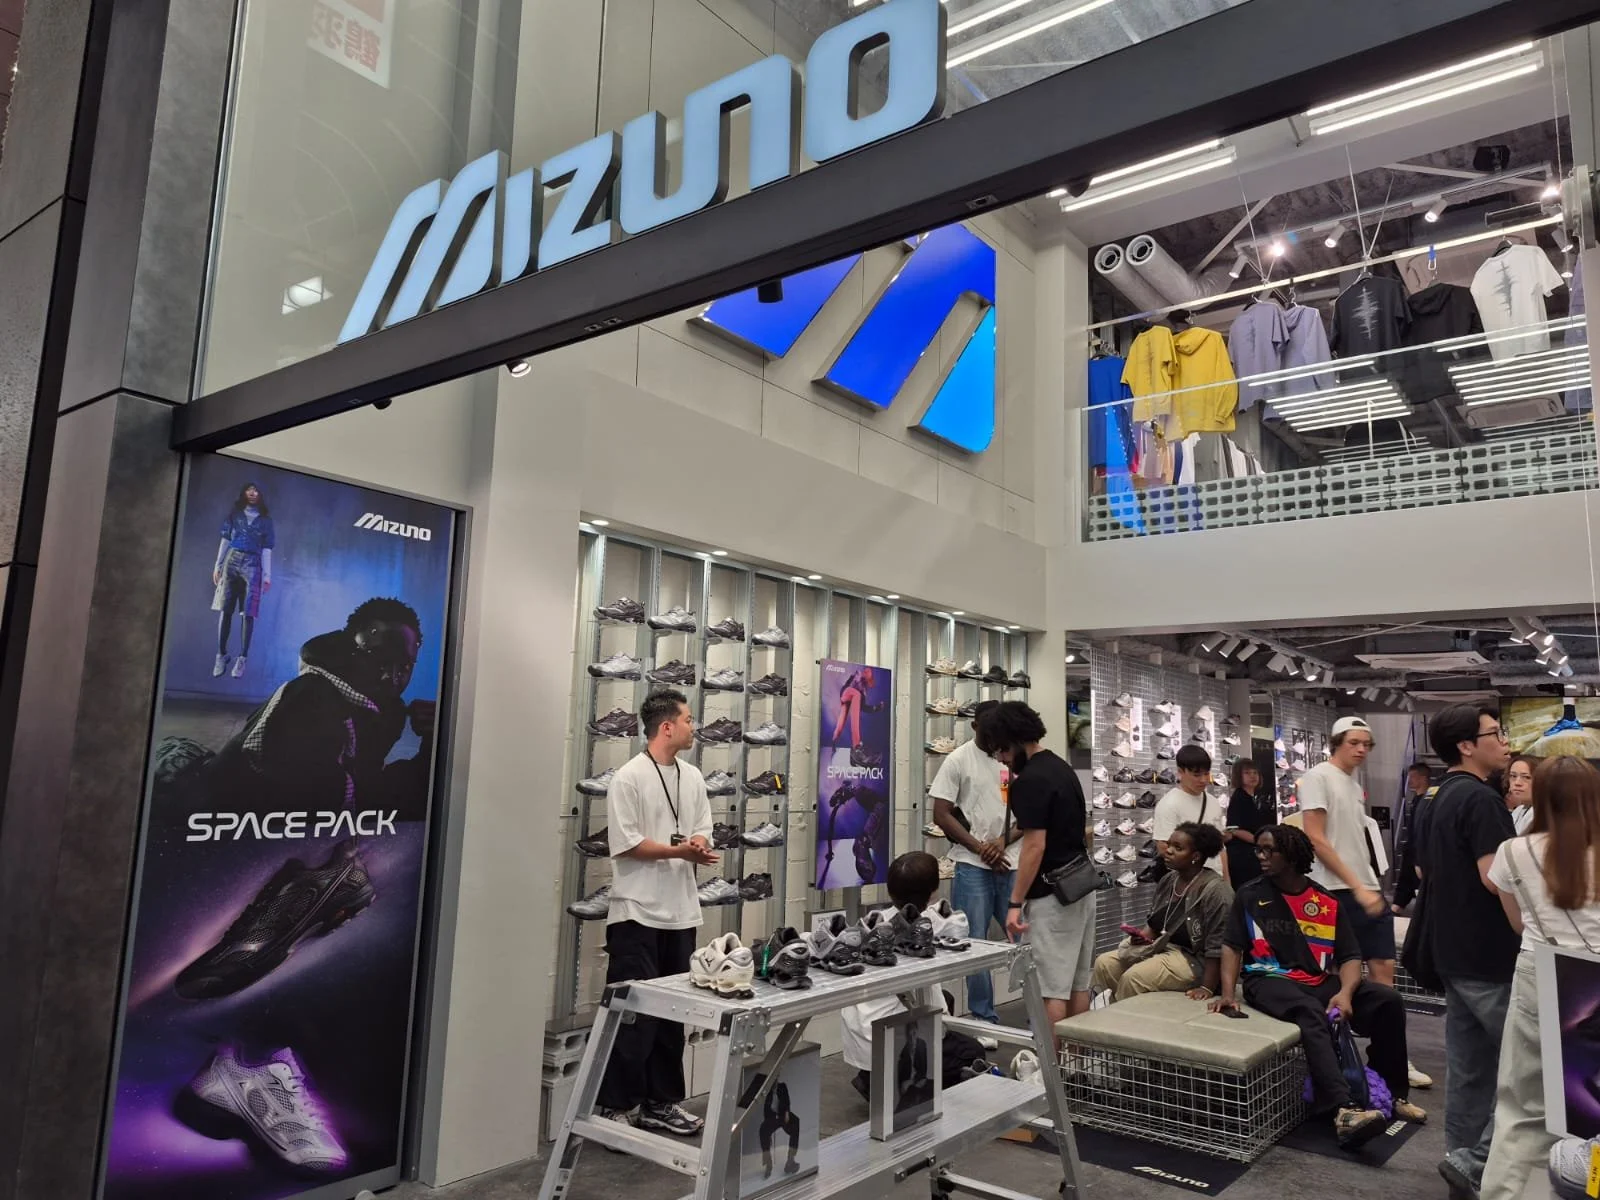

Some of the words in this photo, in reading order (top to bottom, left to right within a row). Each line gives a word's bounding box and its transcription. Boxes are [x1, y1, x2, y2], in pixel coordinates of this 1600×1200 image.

[336, 0, 946, 346] MIZUNO
[353, 512, 432, 541] MIZUNO
[827, 766, 858, 779] SPACE
[859, 766, 884, 780] PACK
[186, 811, 308, 842] SPACE
[313, 809, 398, 838] PACK
